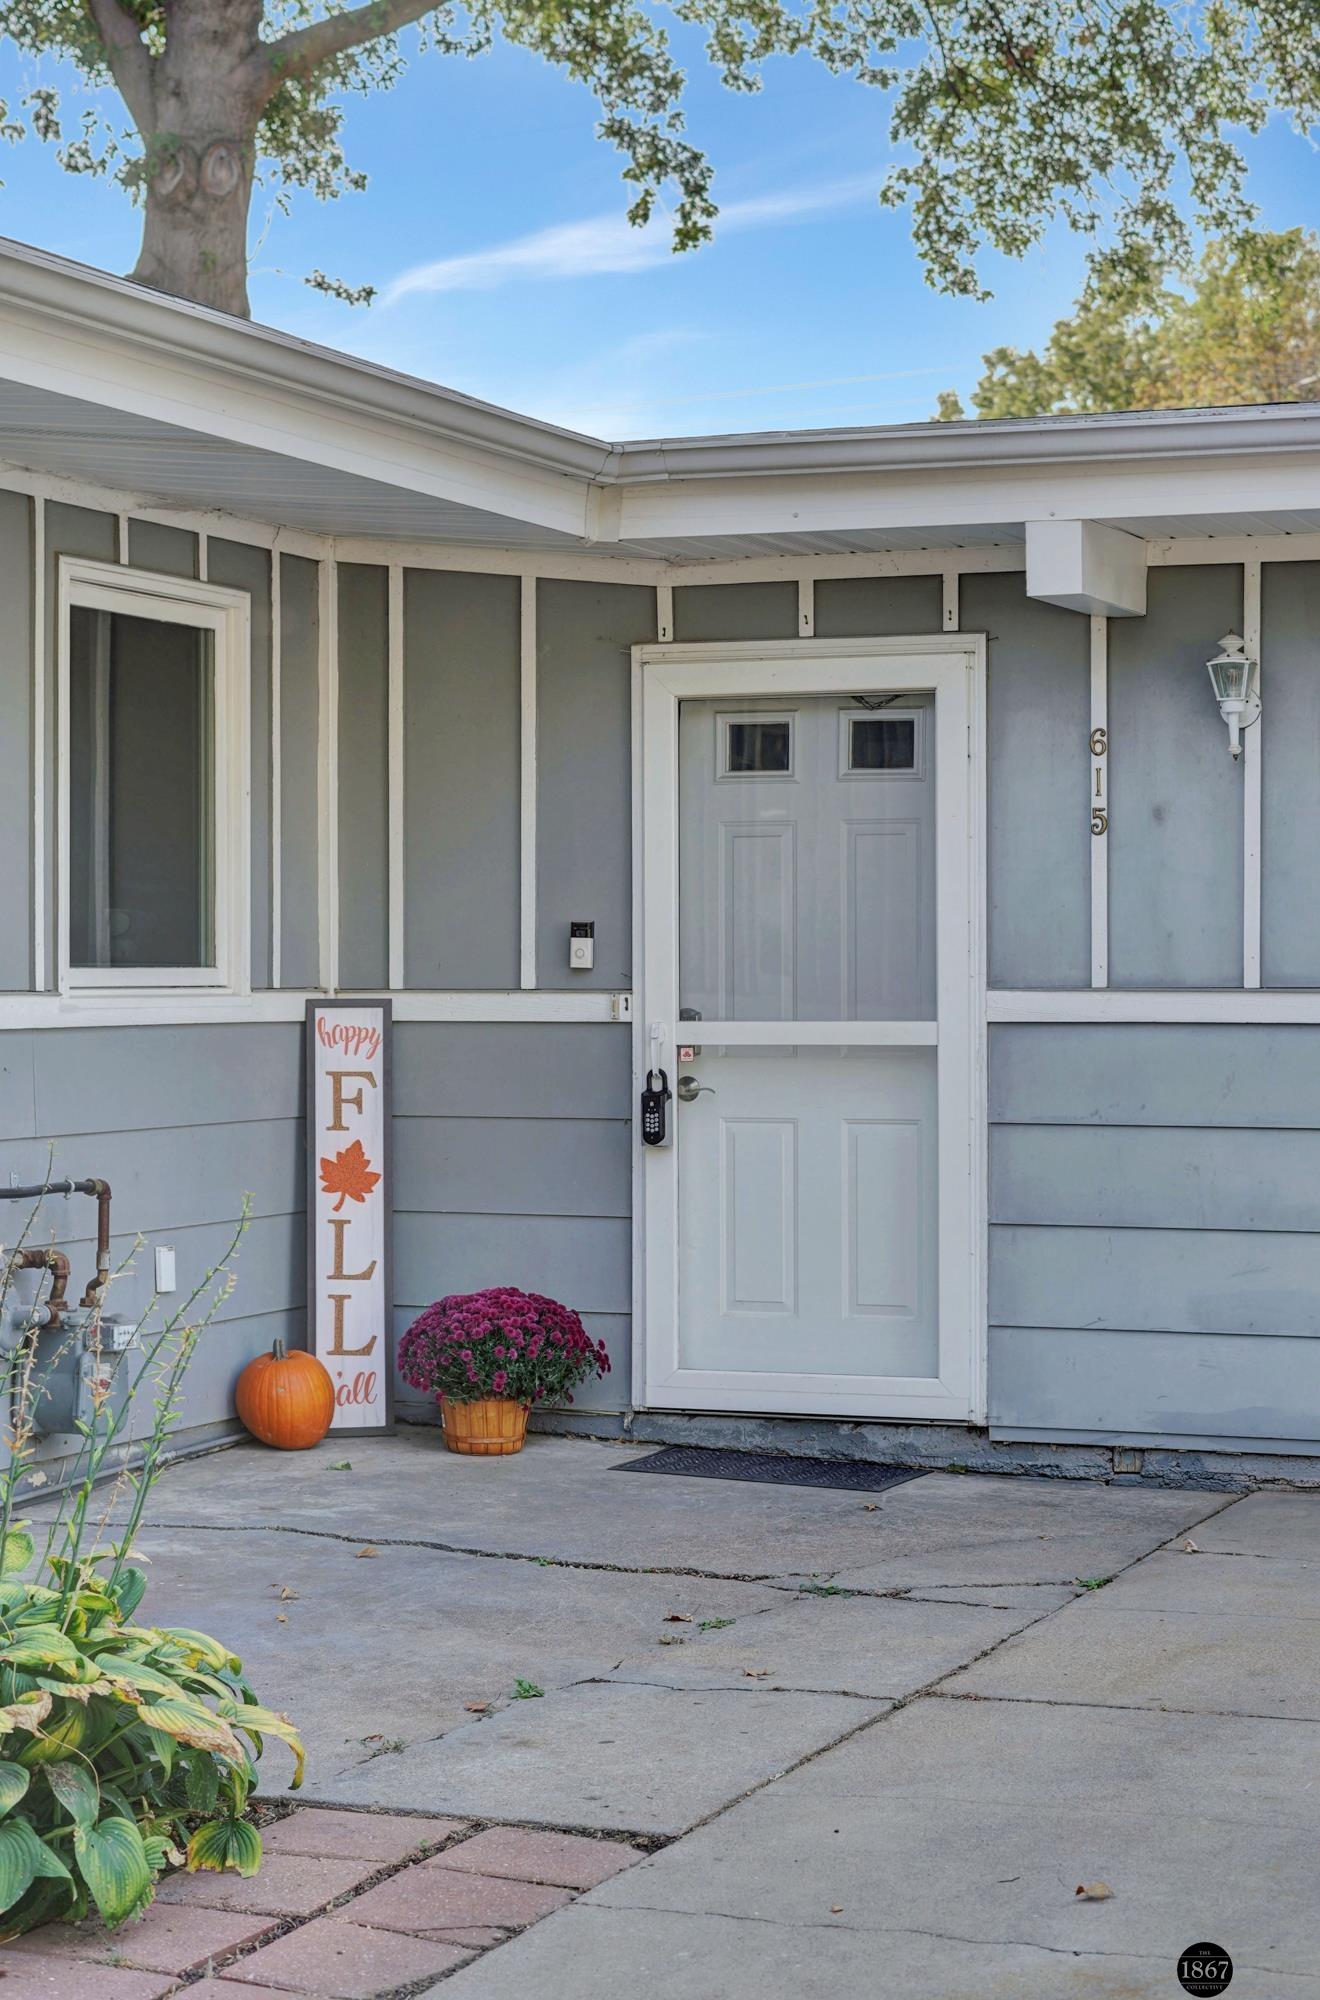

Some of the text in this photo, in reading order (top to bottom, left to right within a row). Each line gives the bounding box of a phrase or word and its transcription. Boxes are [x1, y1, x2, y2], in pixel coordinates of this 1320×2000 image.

[1089, 727, 1108, 836] 615
[317, 1016, 381, 1060] happy
[336, 1371, 378, 1407] 'all
